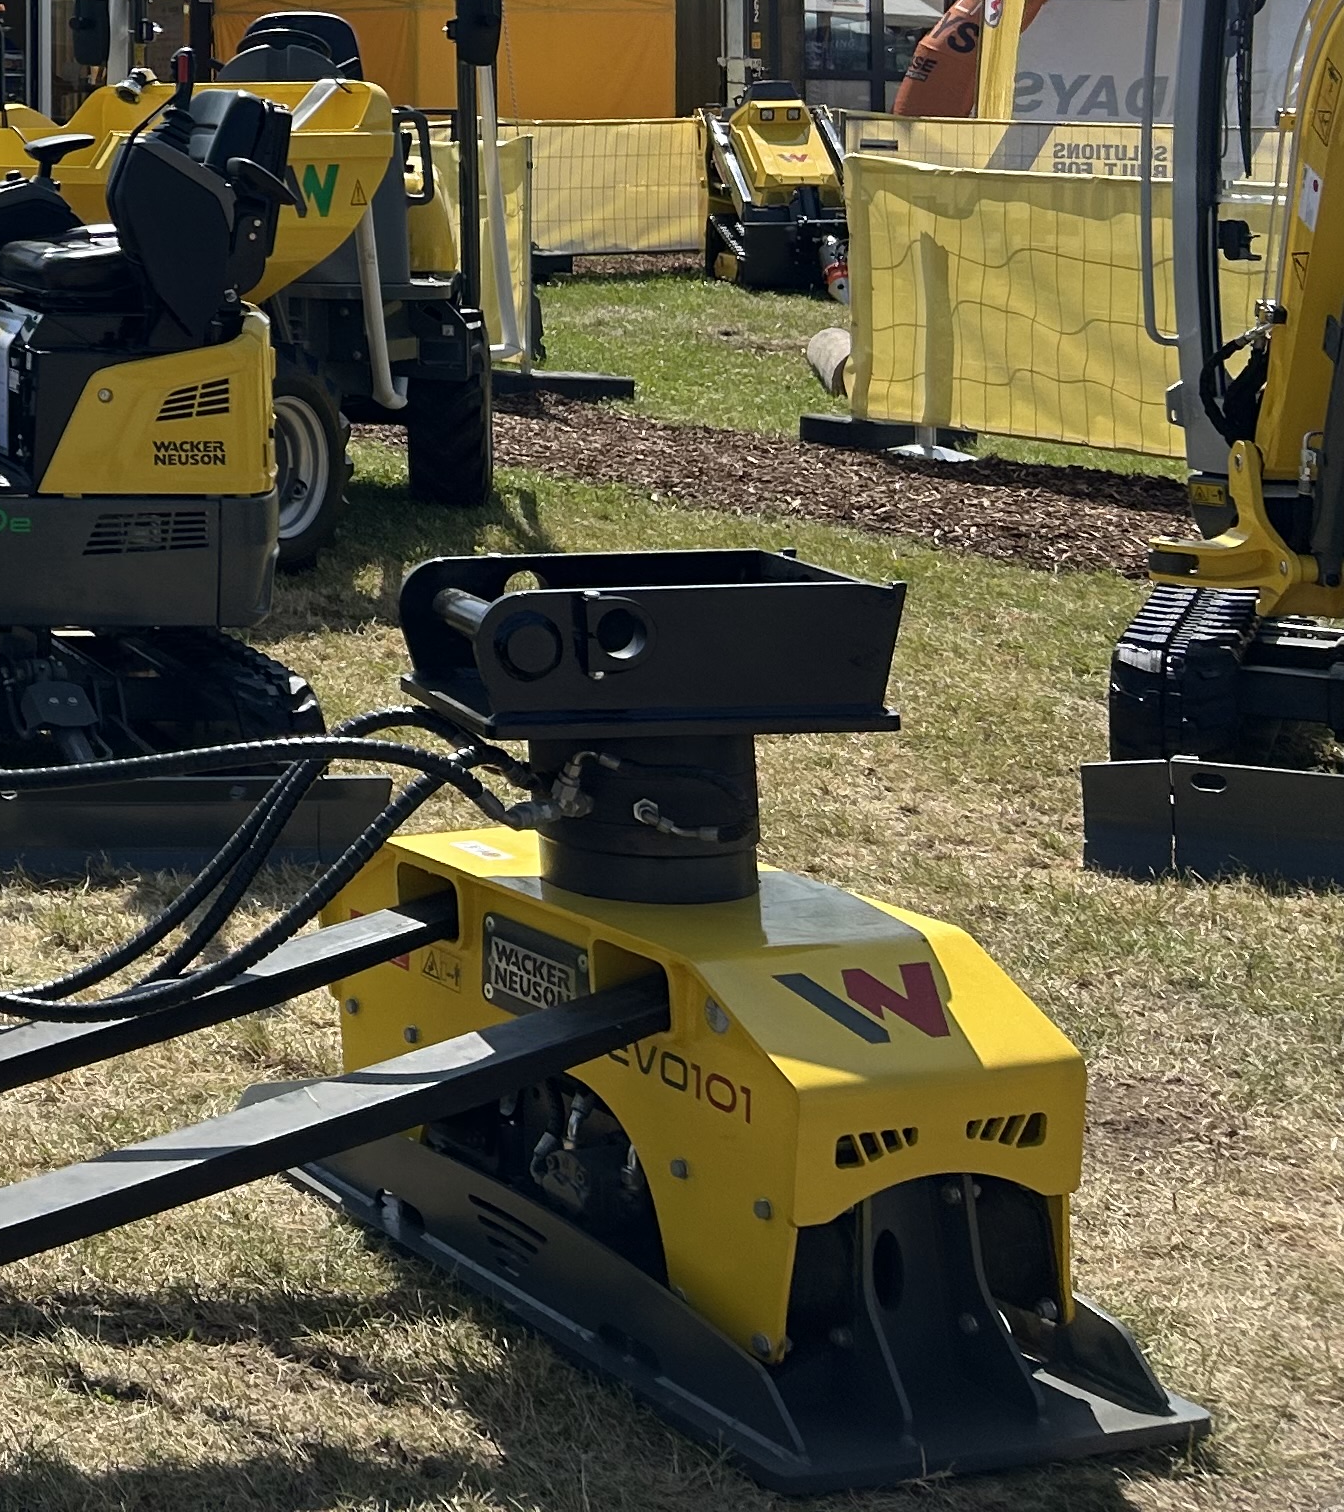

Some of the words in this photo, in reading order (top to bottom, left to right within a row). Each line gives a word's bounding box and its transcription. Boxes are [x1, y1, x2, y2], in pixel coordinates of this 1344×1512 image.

[152, 441, 226, 453] WACKER
[153, 453, 227, 466] NEUSON
[493, 941, 572, 993] WACKER
